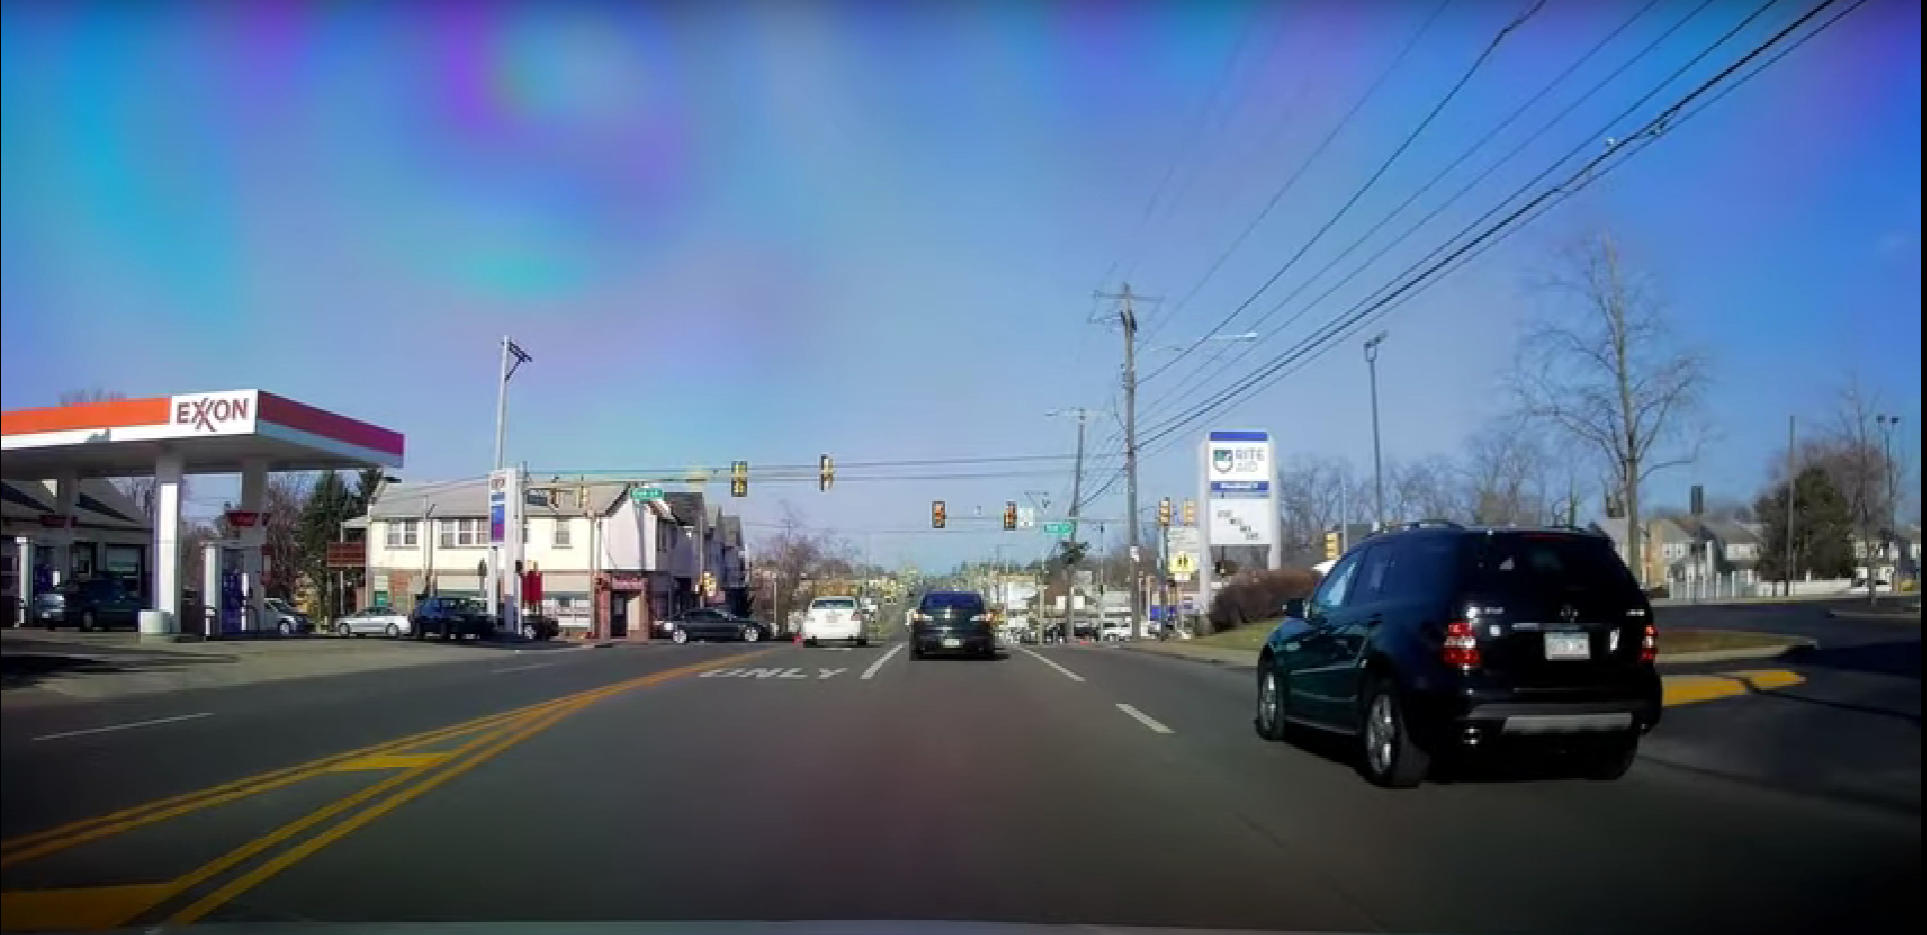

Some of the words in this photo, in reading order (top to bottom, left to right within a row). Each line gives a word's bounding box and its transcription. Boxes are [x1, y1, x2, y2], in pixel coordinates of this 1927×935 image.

[176, 397, 250, 433] EXXON
[1235, 447, 1266, 461] RITE
[1235, 461, 1259, 473] AID
[698, 667, 848, 680] ONLY
